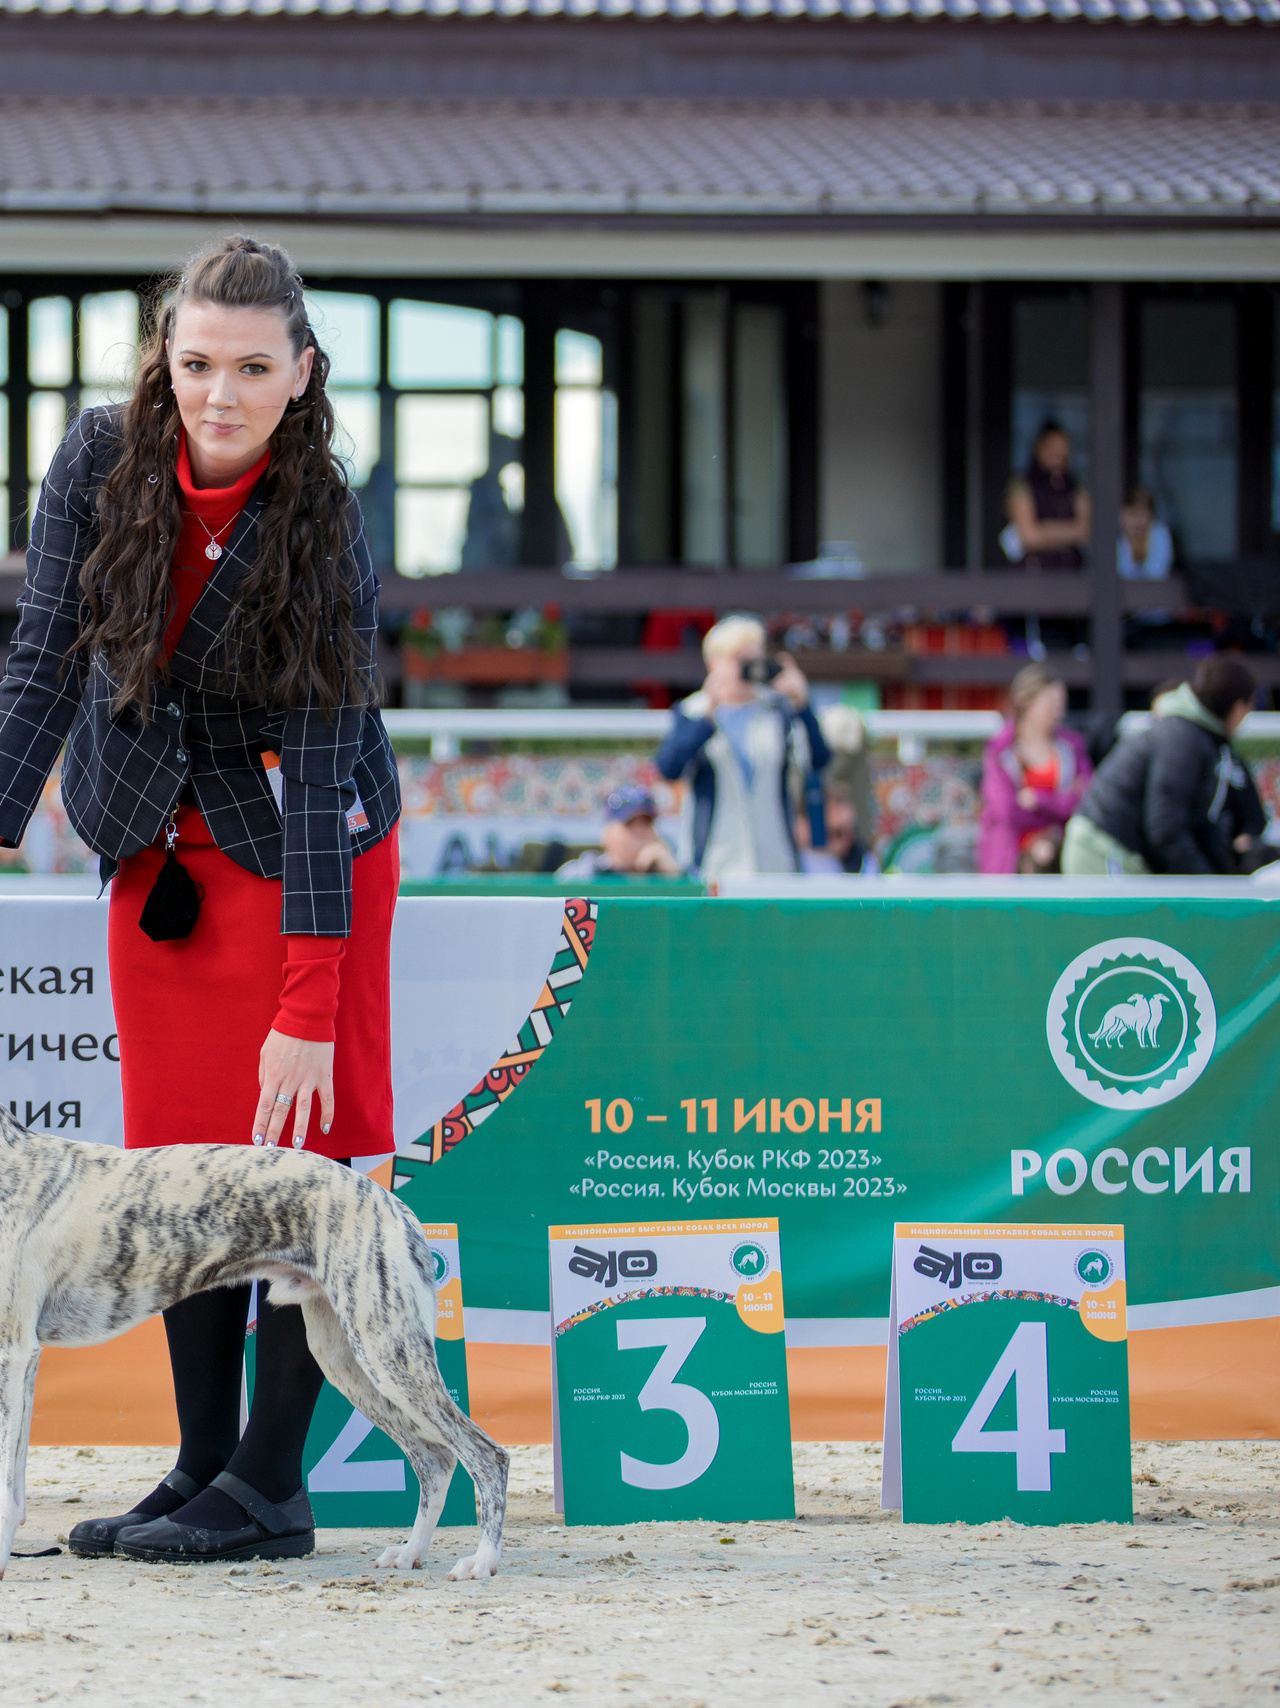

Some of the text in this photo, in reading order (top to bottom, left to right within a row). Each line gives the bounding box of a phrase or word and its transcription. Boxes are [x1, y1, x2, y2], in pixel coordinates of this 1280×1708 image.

[584, 1098, 634, 1134] 10
[680, 1098, 718, 1134] 11
[734, 1098, 882, 1134] ИЮНЯ
[584, 1148, 882, 1174] «Россия. Кубок РКФ 2023»
[1010, 1146, 1252, 1196] РОССИЯ
[569, 1177, 908, 1203] «Россия. Кубок Москвы 2023»
[565, 1226, 636, 1236] НАЦИОНАЛЬНЫЕ
[638, 1225, 683, 1233] ВЫСТАВКИ
[740, 1222, 769, 1230] ПОРОД
[910, 1228, 981, 1236] НАЦИОНАЛЬНЫЕ
[983, 1228, 1029, 1236] ВЫСТАВКИ
[444, 1299, 453, 1307] 11
[742, 1293, 754, 1301] 10
[763, 1292, 772, 1300] 11
[743, 1303, 774, 1311] ИЮНЯ
[1086, 1300, 1098, 1309] 10
[1106, 1300, 1116, 1309] 11
[1086, 1311, 1117, 1319] ИЮНЯ
[616, 1316, 720, 1490] 3
[951, 1322, 1066, 1492] 4
